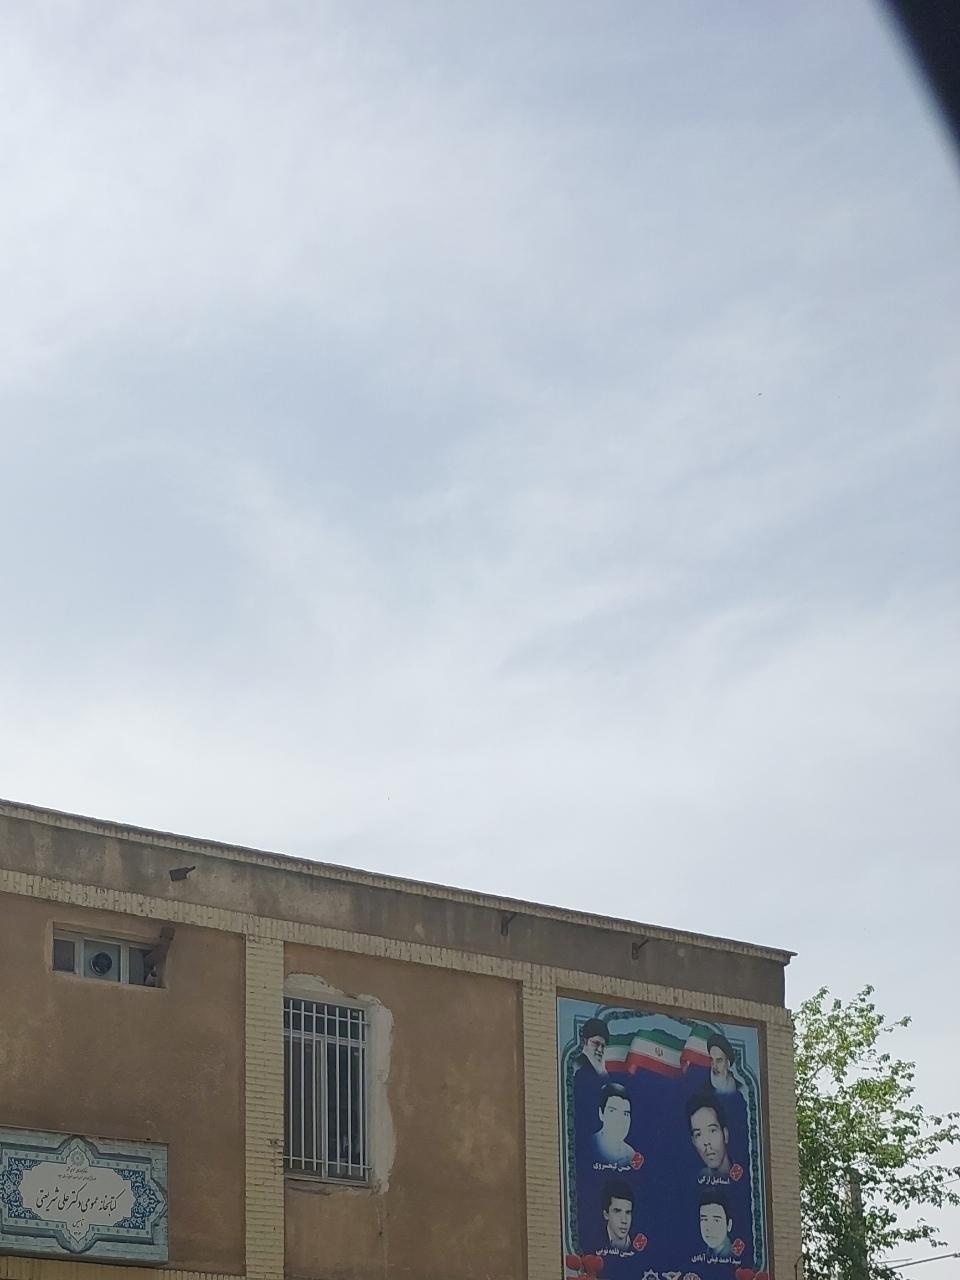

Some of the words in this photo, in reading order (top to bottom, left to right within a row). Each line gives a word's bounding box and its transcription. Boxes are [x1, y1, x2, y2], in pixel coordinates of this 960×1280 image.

[36, 1186, 59, 1212] شریعتی
[57, 1193, 70, 1210] علی
[67, 1182, 88, 1210] دکتر
[80, 1196, 98, 1212] عمومی
[98, 1188, 126, 1217] کتابخانه
